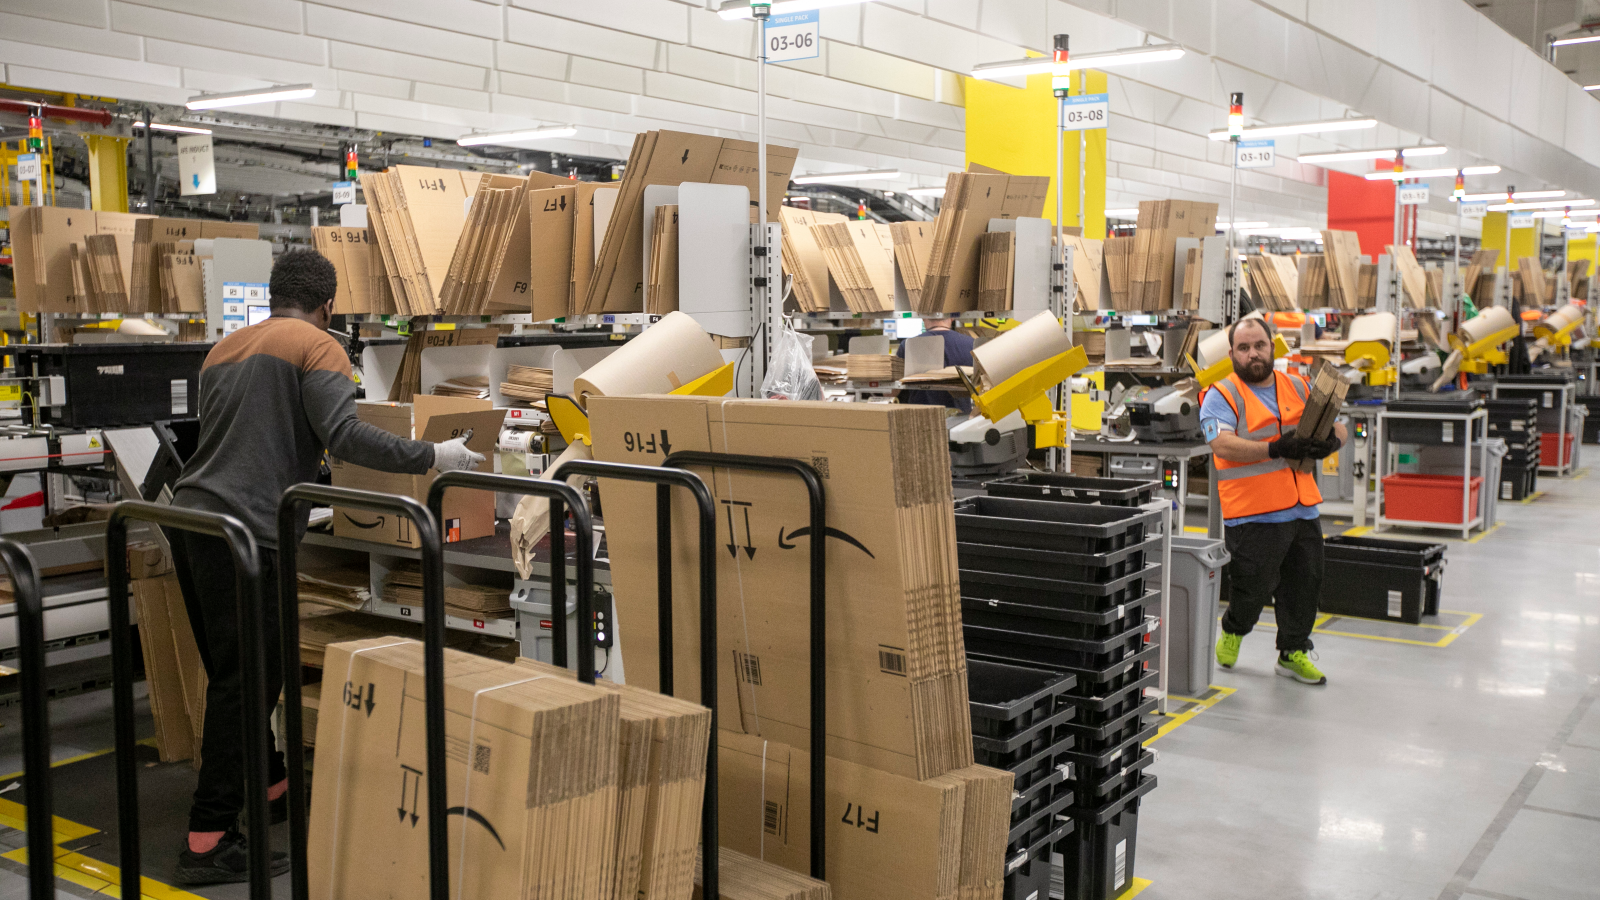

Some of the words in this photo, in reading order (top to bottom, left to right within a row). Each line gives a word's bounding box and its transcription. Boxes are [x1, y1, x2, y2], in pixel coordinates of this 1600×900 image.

[775, 16, 794, 24] SINGLE
[770, 32, 813, 51] 03-06
[1068, 109, 1103, 122] 03-08
[1240, 152, 1270, 162] 03-10
[20, 165, 35, 174] 03-07
[419, 179, 438, 190] F11
[335, 191, 350, 199] 03-09
[543, 198, 557, 212] F7
[346, 232, 361, 243] F6
[513, 281, 528, 294] F9
[634, 282, 643, 293] F
[624, 431, 657, 454] F16
[343, 681, 363, 711] F9
[842, 802, 880, 834] F17
